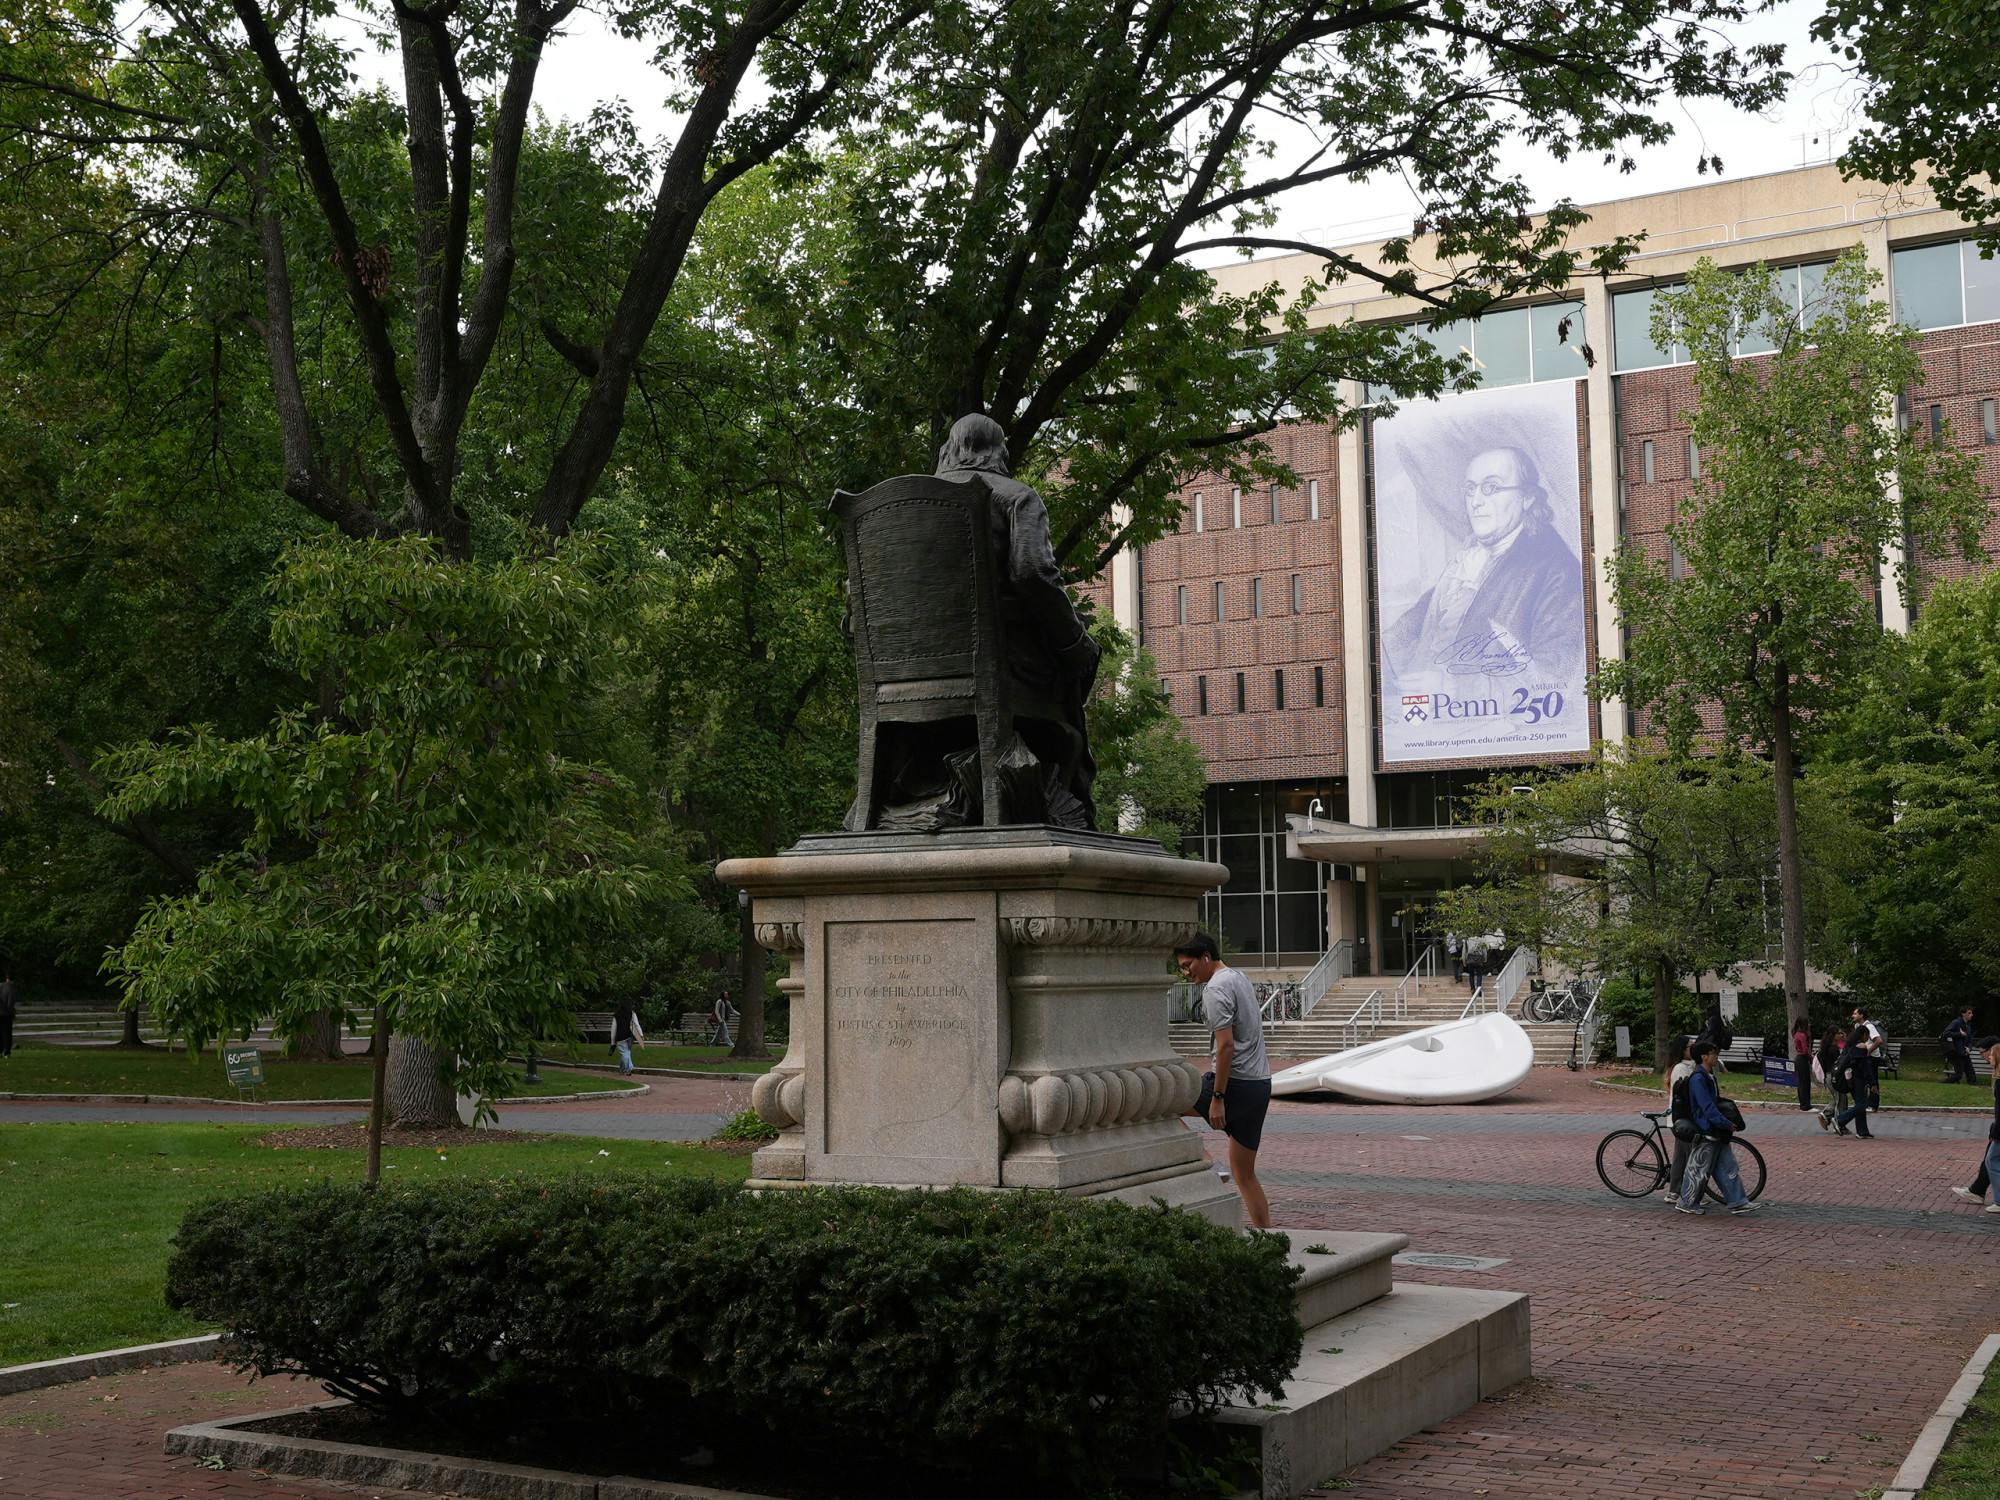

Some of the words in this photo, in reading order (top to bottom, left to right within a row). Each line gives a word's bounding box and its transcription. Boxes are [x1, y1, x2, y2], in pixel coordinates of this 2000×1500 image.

[1432, 693, 1500, 719] Penn
[1510, 687, 1565, 724] 250
[1404, 733, 1567, 748] www.library.upenn.edu/america-250-penn
[868, 954, 932, 965] PRESENTED
[888, 971, 897, 979] to
[897, 969, 911, 979] the
[835, 986, 861, 998] CITY
[863, 986, 879, 997] OF
[882, 985, 968, 997] PHILADELPHIA
[896, 1002, 906, 1014] by
[888, 1037, 913, 1049] 1899
[228, 1054, 240, 1064] 60
